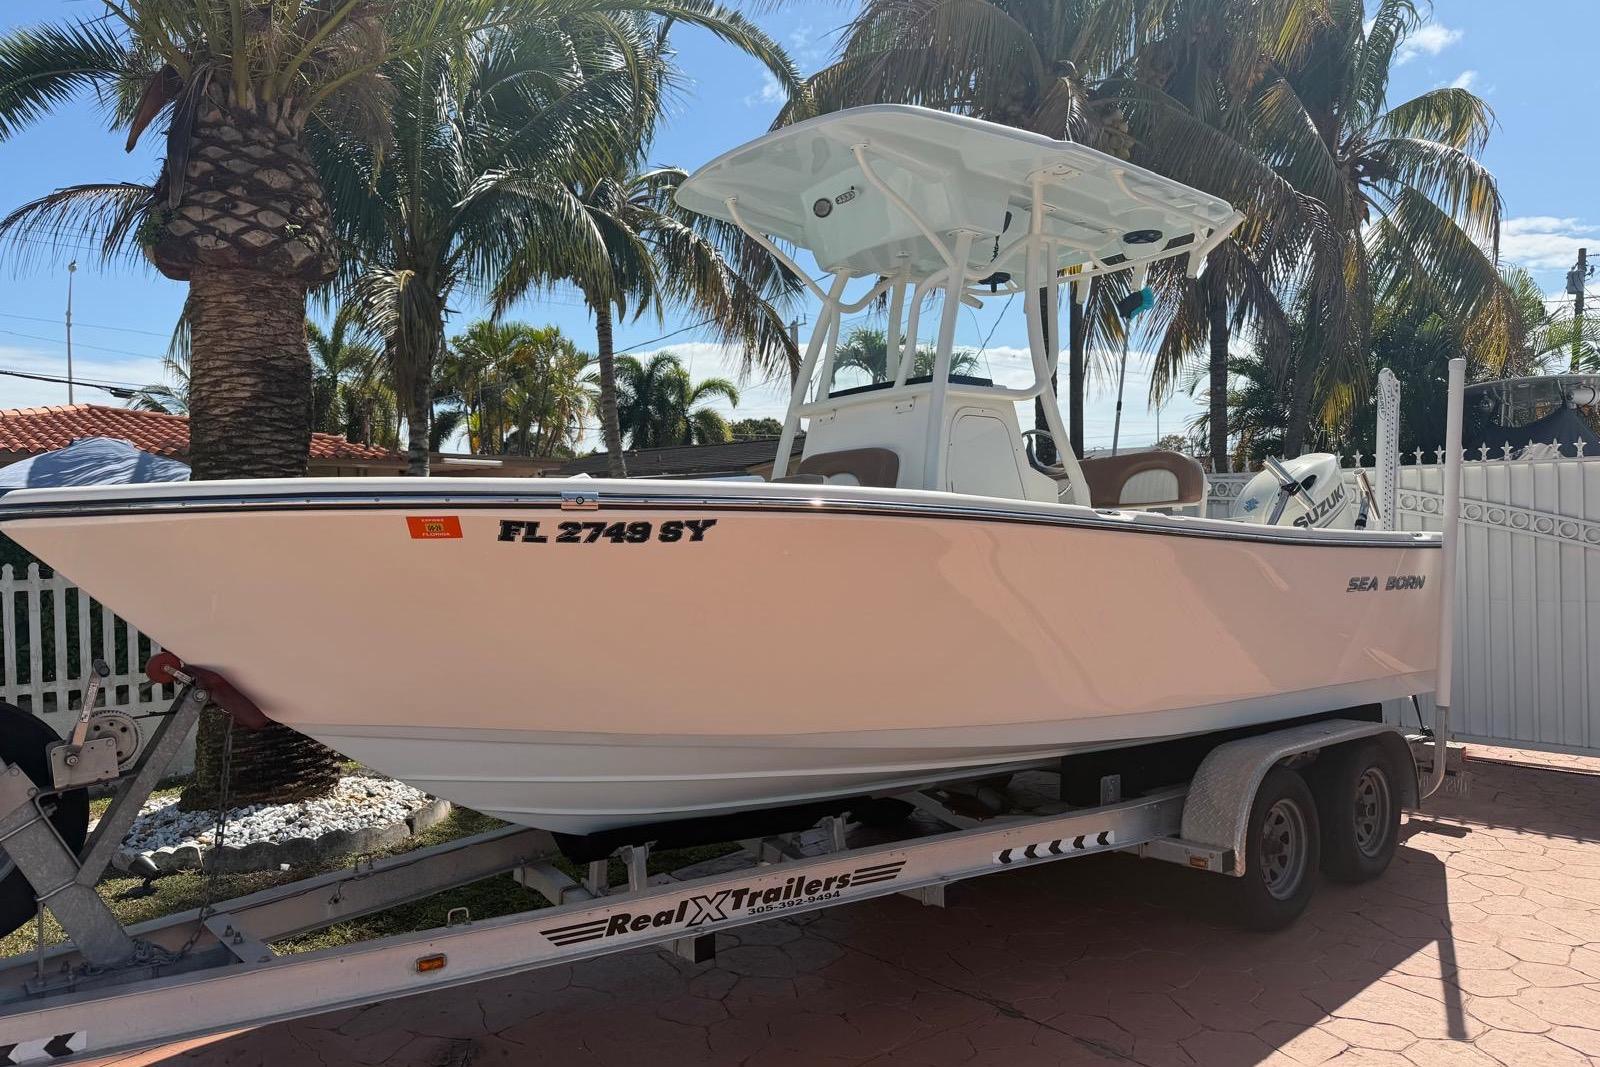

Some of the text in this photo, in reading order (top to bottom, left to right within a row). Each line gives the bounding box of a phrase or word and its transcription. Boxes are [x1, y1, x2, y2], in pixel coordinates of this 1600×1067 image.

[1293, 482, 1345, 528] SUZUKI
[497, 518, 717, 544] FL 2749 SY
[1346, 576, 1426, 592] SEA BORN
[731, 872, 851, 910] Trailers
[748, 890, 841, 915] 305-392-9494
